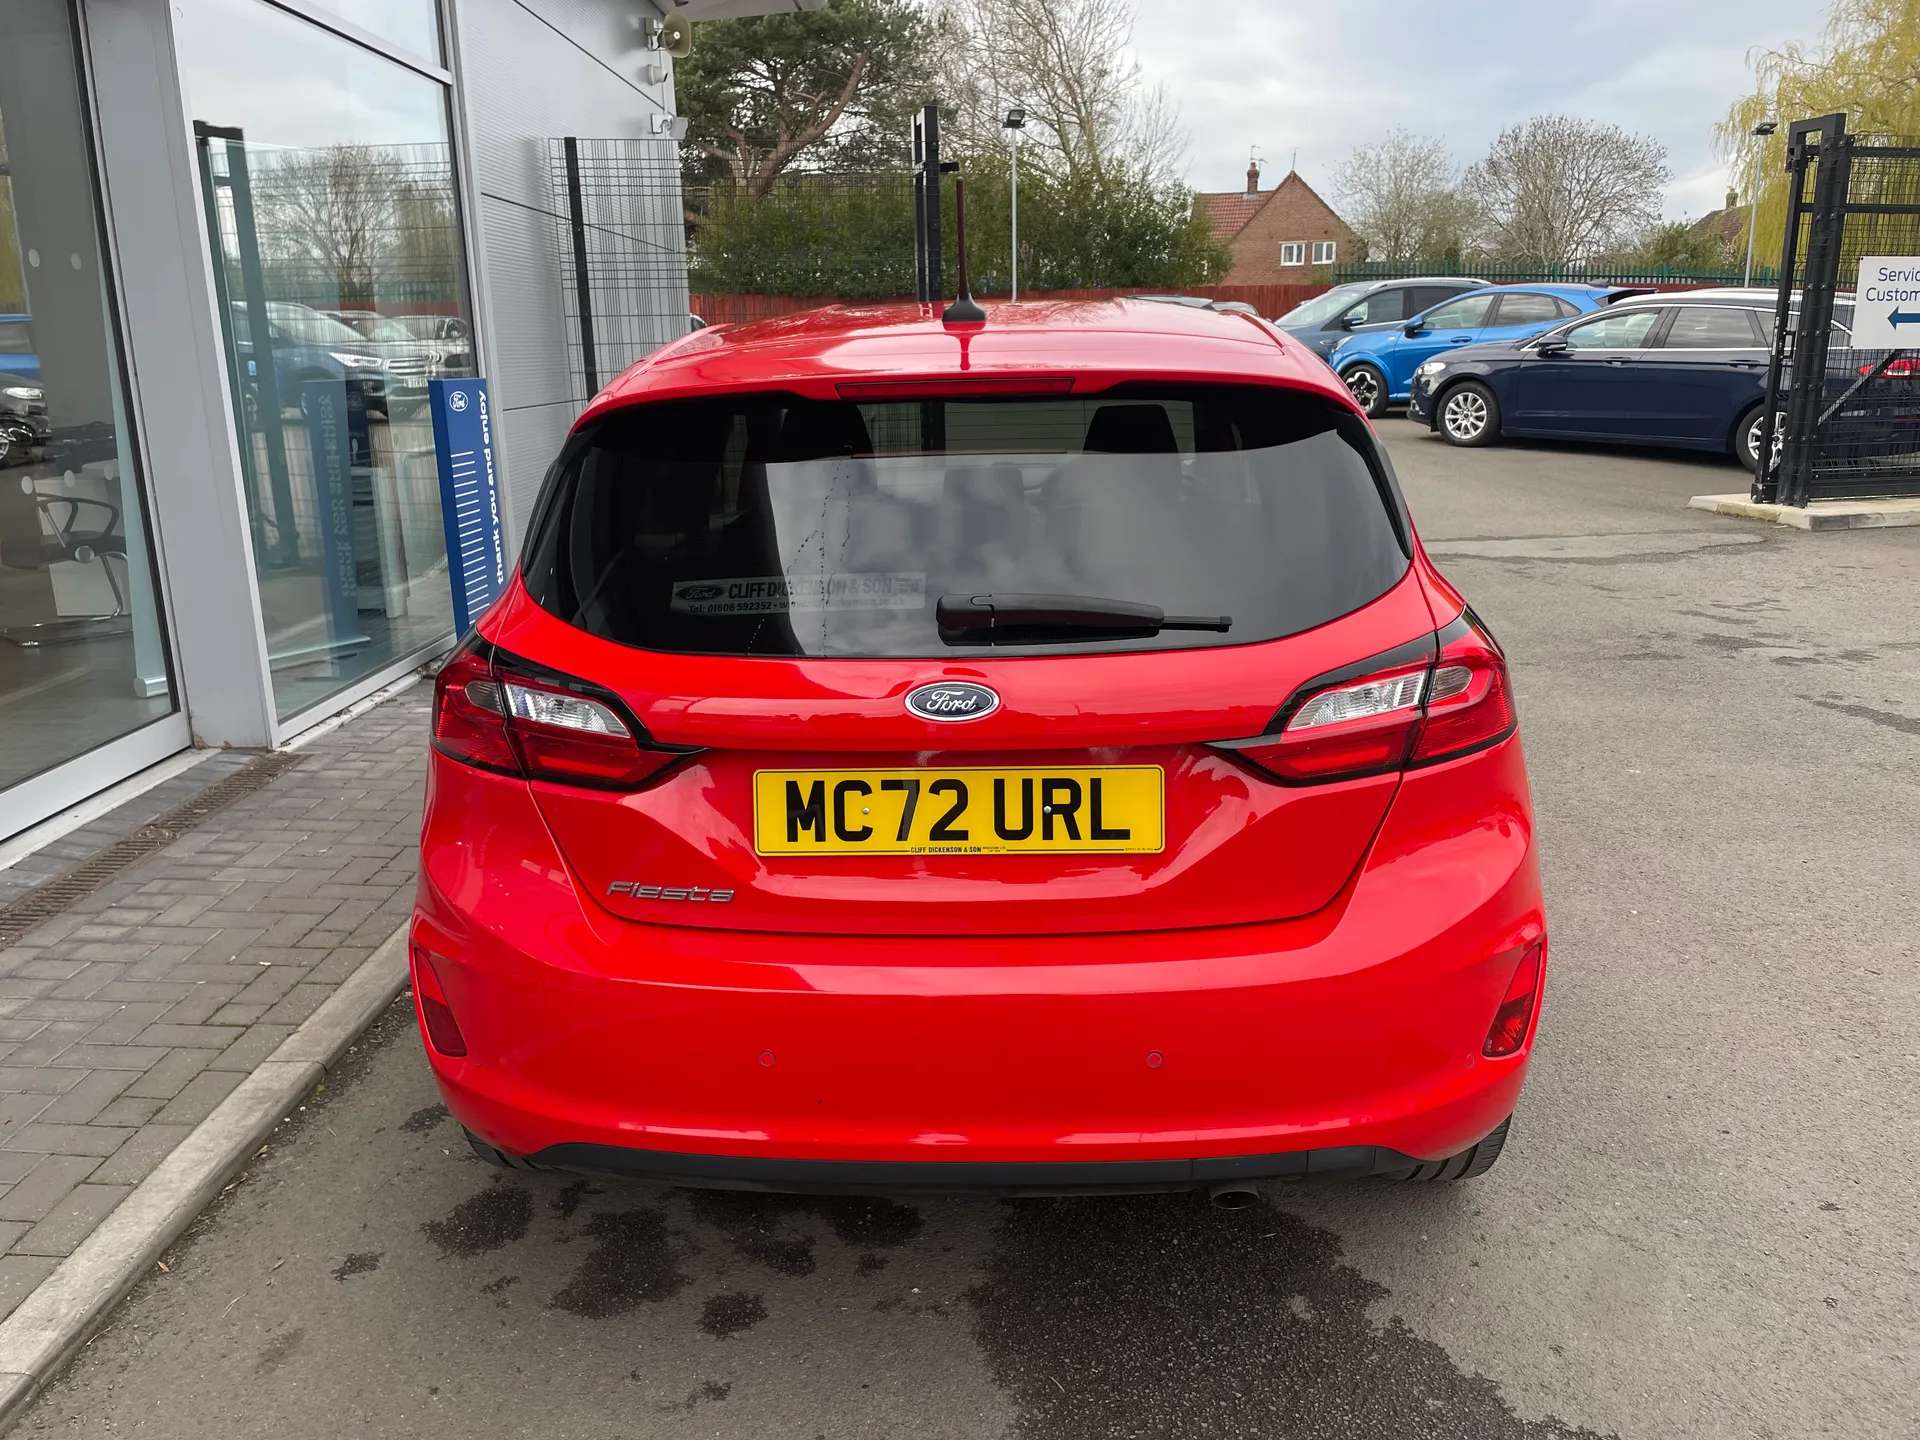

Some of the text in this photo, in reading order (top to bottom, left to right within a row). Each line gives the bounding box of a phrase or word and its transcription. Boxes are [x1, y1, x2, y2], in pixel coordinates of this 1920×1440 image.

[1866, 287, 1920, 302] Custom
[478, 389, 504, 584] thank you and enjoy
[728, 583, 765, 599] CLIFF
[862, 577, 892, 594] SON
[736, 601, 772, 611] 592352
[926, 690, 977, 711] Ford
[785, 777, 1132, 843] MC72 URL
[606, 880, 735, 902] Fiesta
